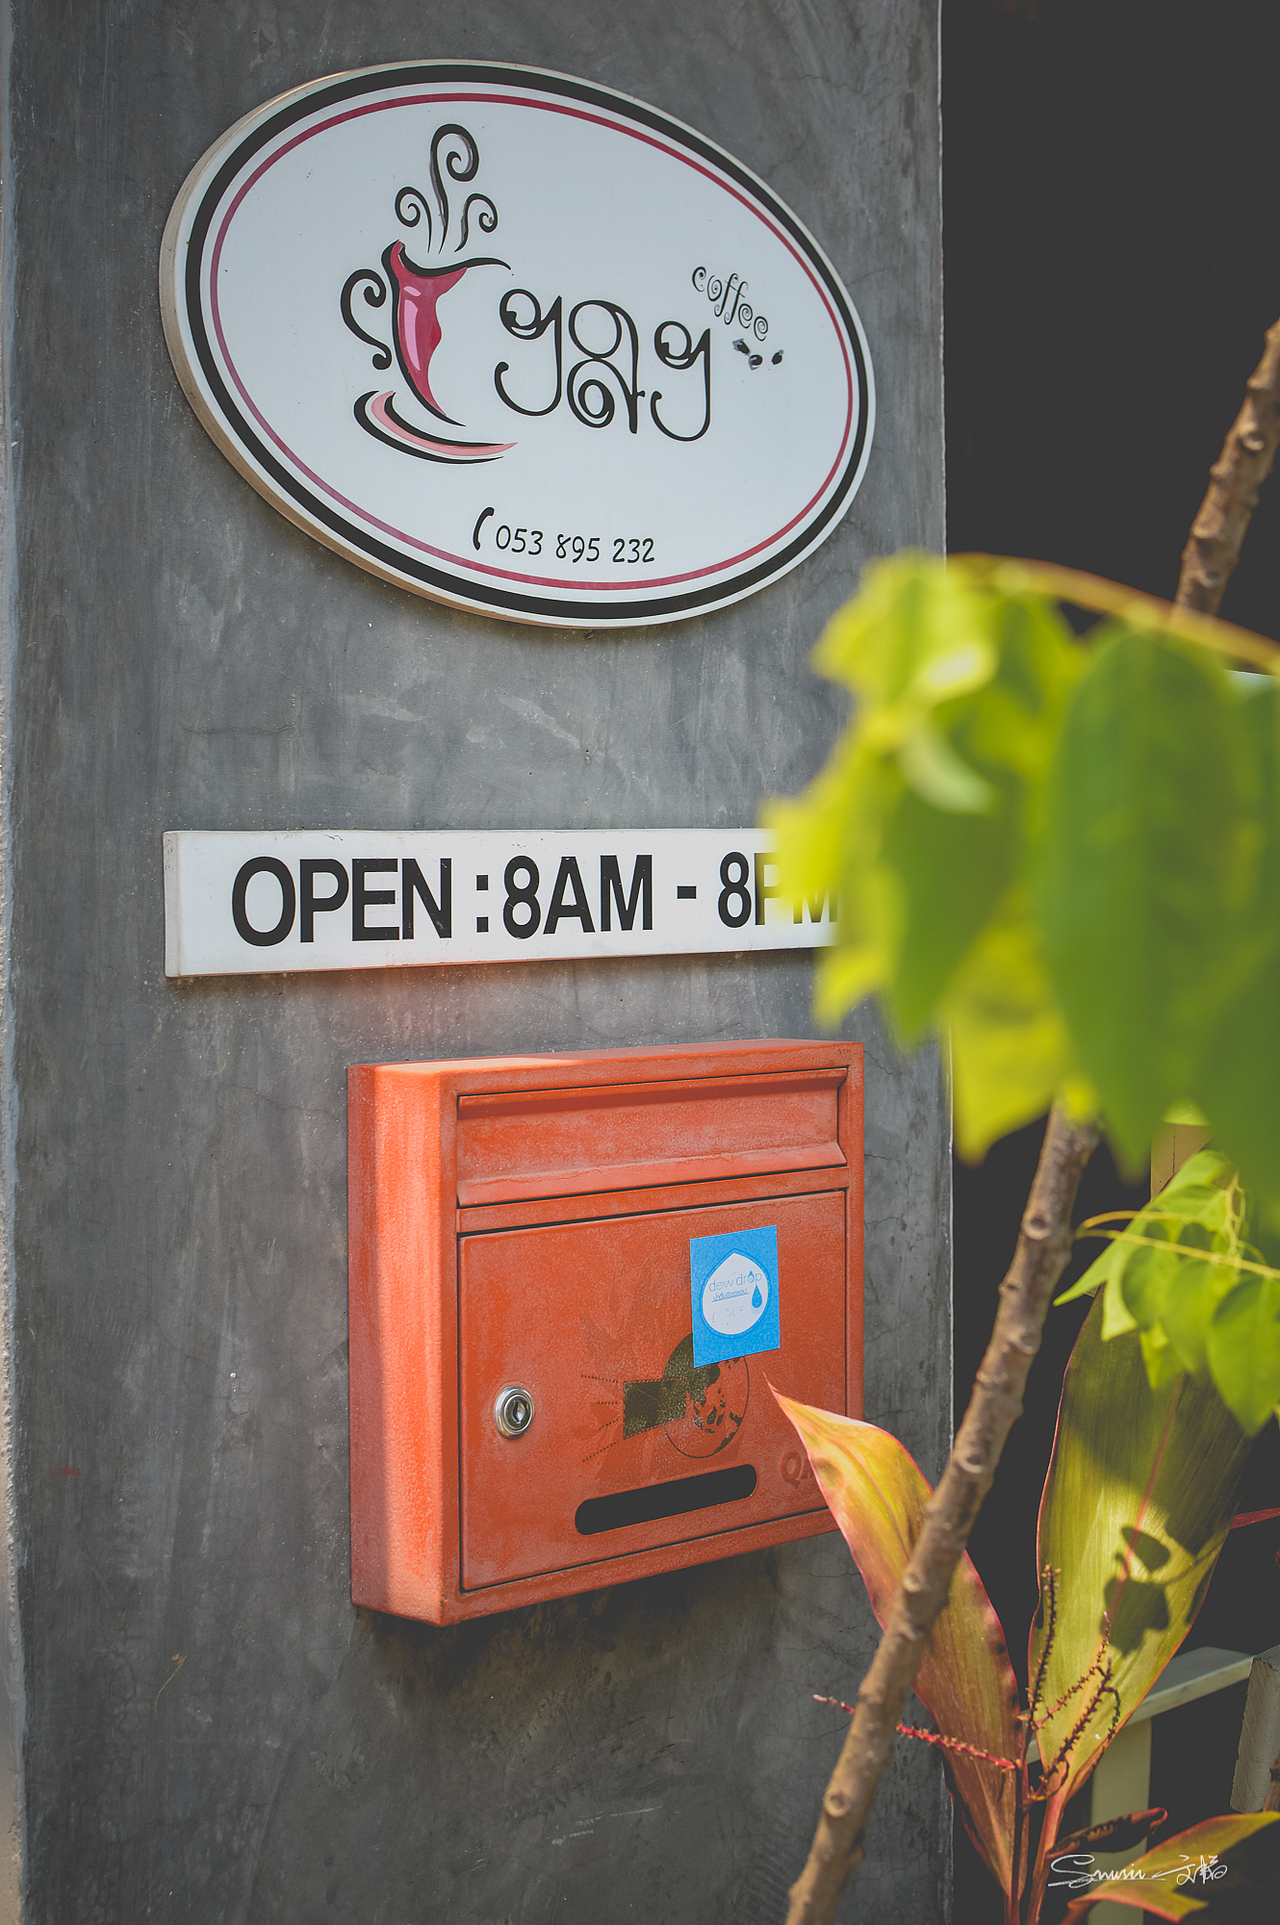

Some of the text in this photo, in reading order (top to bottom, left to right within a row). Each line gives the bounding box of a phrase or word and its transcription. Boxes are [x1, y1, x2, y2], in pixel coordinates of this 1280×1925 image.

[691, 265, 769, 342] coffee
[495, 525, 656, 564] 053 895 232
[708, 1270, 763, 1292] dew drop
